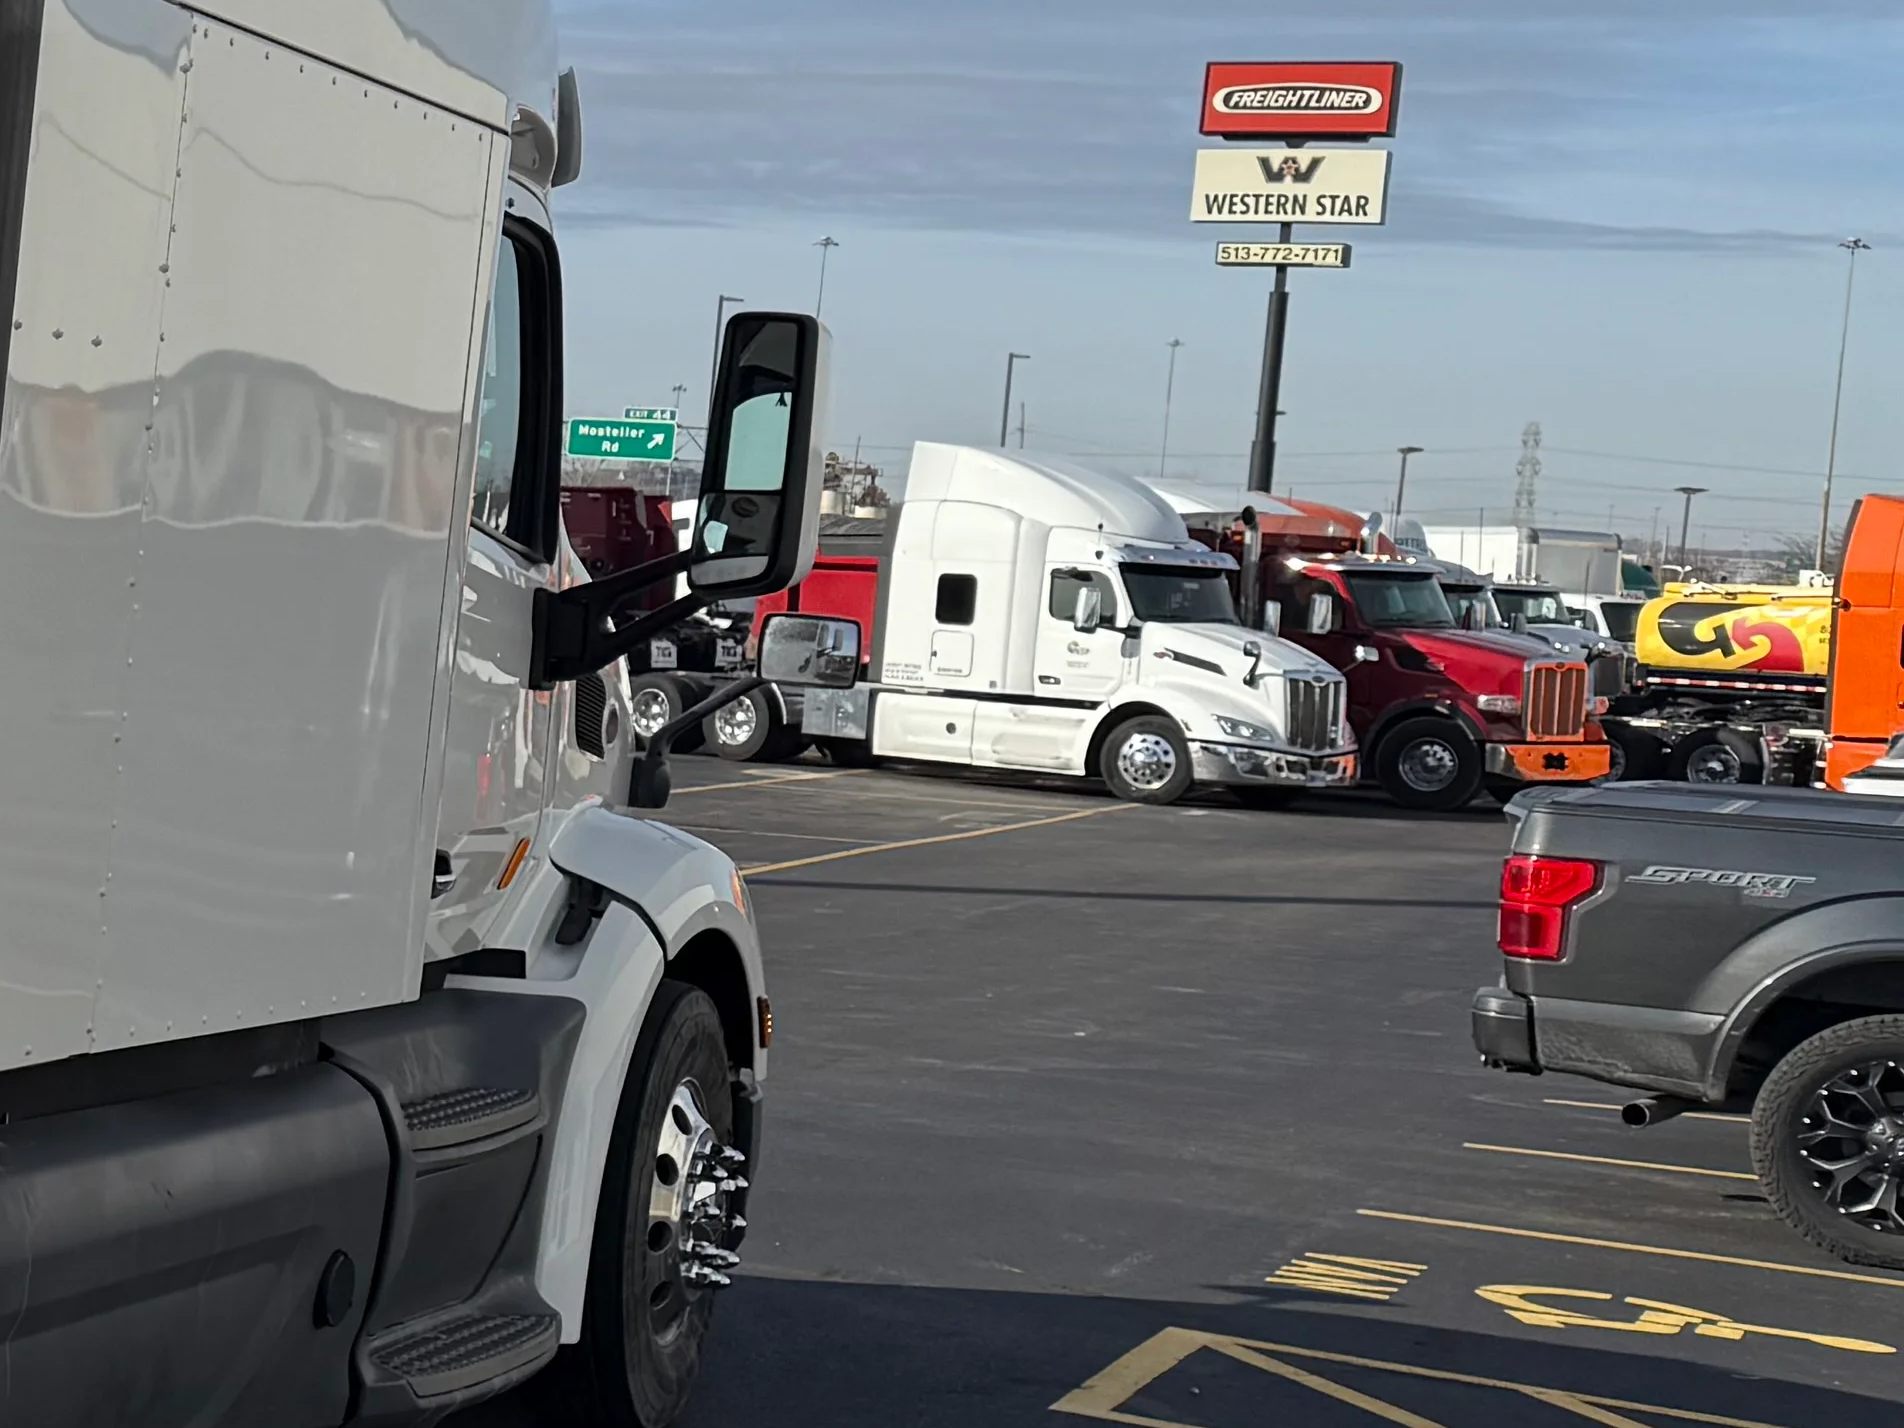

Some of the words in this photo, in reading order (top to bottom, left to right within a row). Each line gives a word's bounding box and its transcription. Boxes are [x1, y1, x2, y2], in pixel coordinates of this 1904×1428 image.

[1228, 89, 1367, 108] FREIGHTLINER
[1205, 193, 1307, 216] WESTERN
[1316, 194, 1370, 217] STAR
[1220, 246, 1340, 261] 513-772-7171
[652, 410, 672, 420] 44
[601, 441, 619, 453] Rd
[1624, 865, 1817, 888] SPORT
